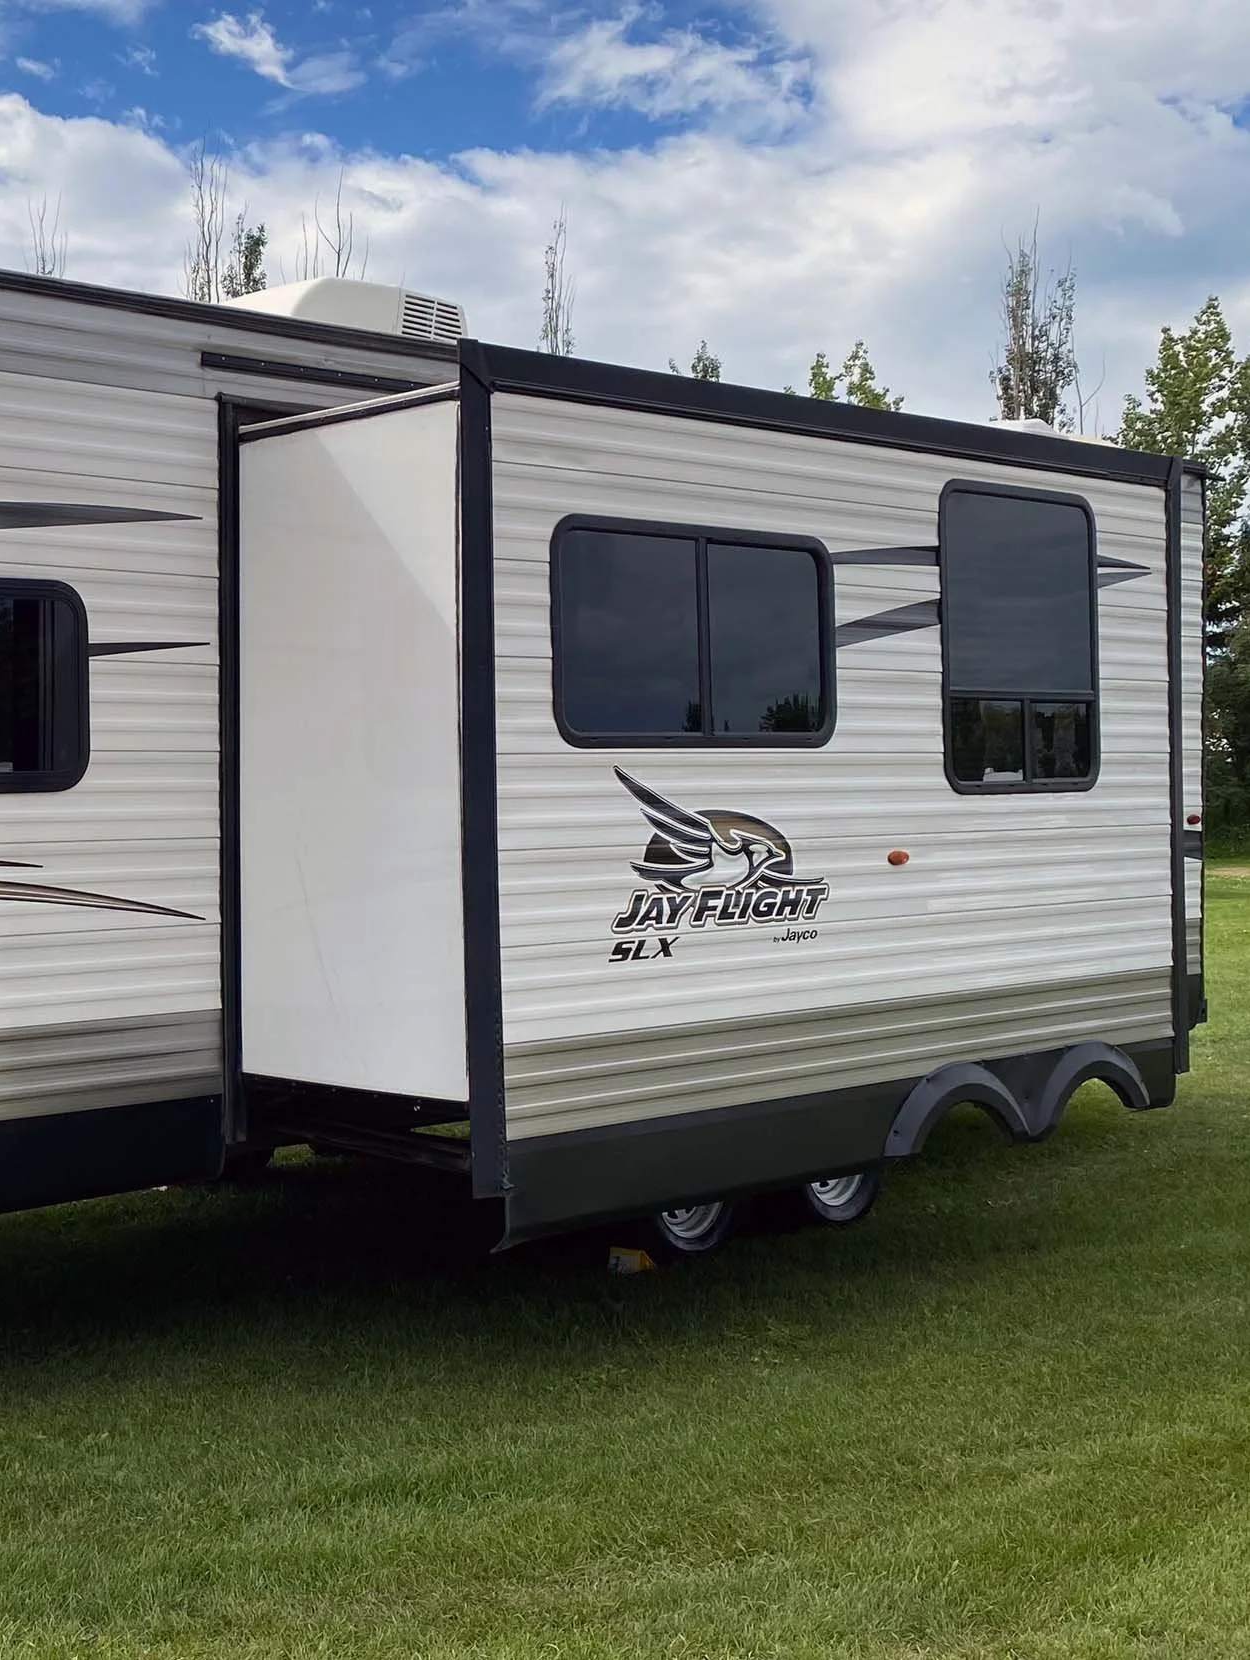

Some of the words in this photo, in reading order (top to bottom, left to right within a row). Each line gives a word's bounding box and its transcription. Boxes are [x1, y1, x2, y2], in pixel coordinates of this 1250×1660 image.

[611, 889, 695, 934] JAY
[689, 882, 830, 929] FLIGHT
[781, 928, 818, 943] Jayco
[608, 936, 680, 962] SLX
